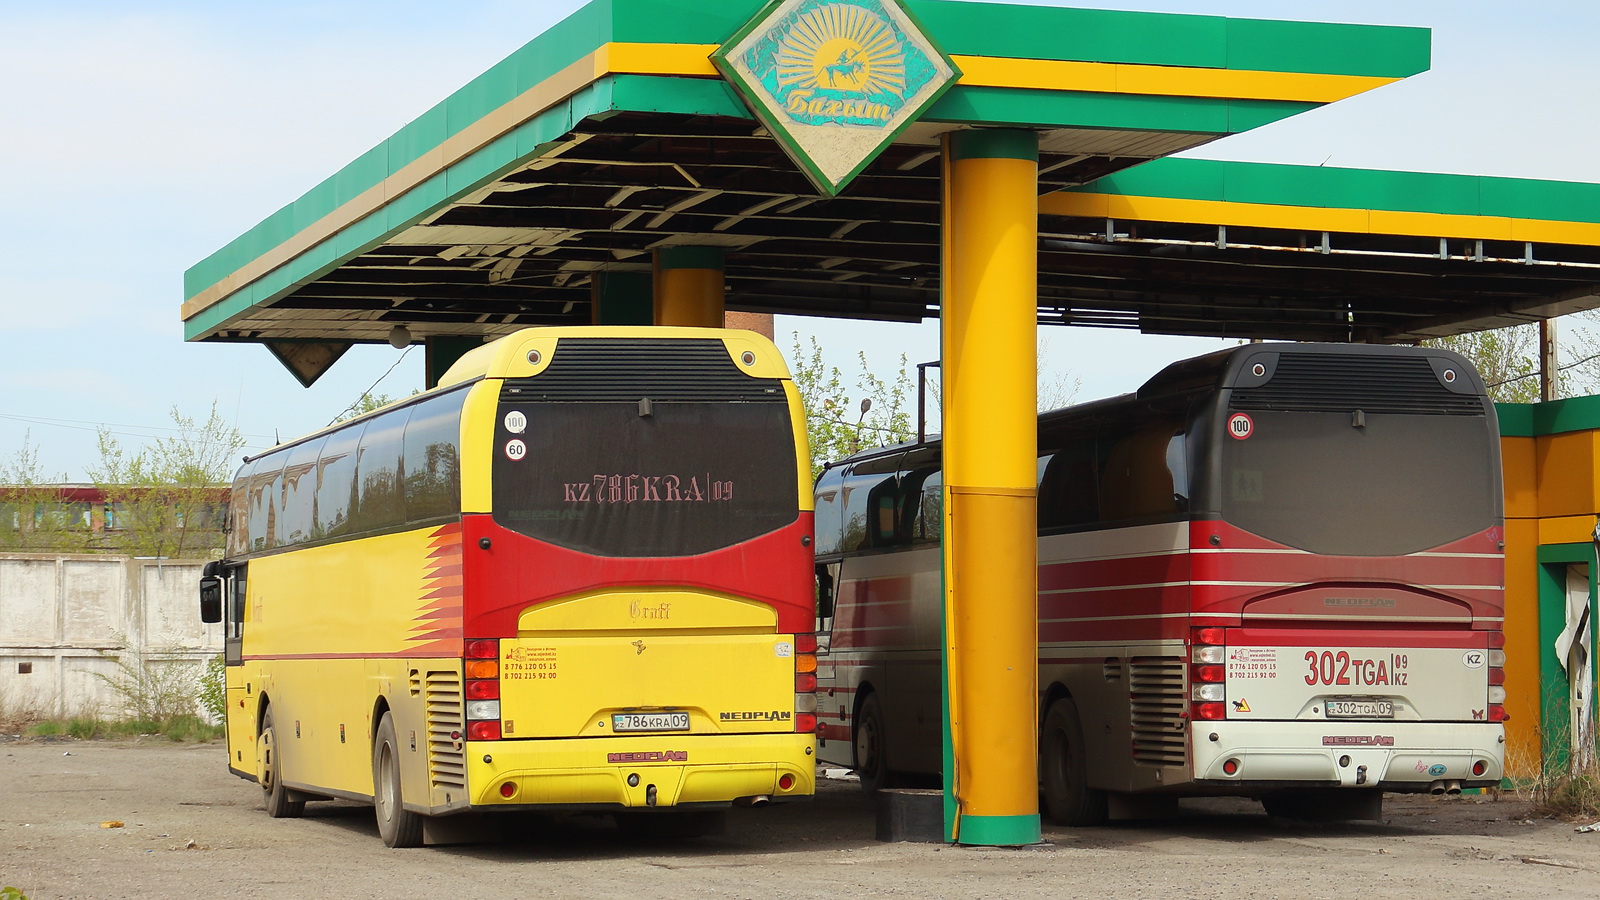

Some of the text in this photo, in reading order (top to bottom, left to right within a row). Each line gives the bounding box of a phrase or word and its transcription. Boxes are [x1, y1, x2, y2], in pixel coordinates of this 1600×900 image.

[508, 417, 524, 428] 100
[1233, 420, 1249, 432] 100
[509, 445, 523, 455] 60
[1324, 597, 1396, 608] NEOPLAN
[1395, 654, 1408, 669] 09
[1467, 654, 1481, 664] KZ
[511, 672, 523, 680] 702
[1395, 673, 1408, 686] KZ
[720, 711, 790, 722] NEOPLAN
[1322, 735, 1394, 746] NEOPLAN
[608, 750, 687, 763] NEOPLAN
